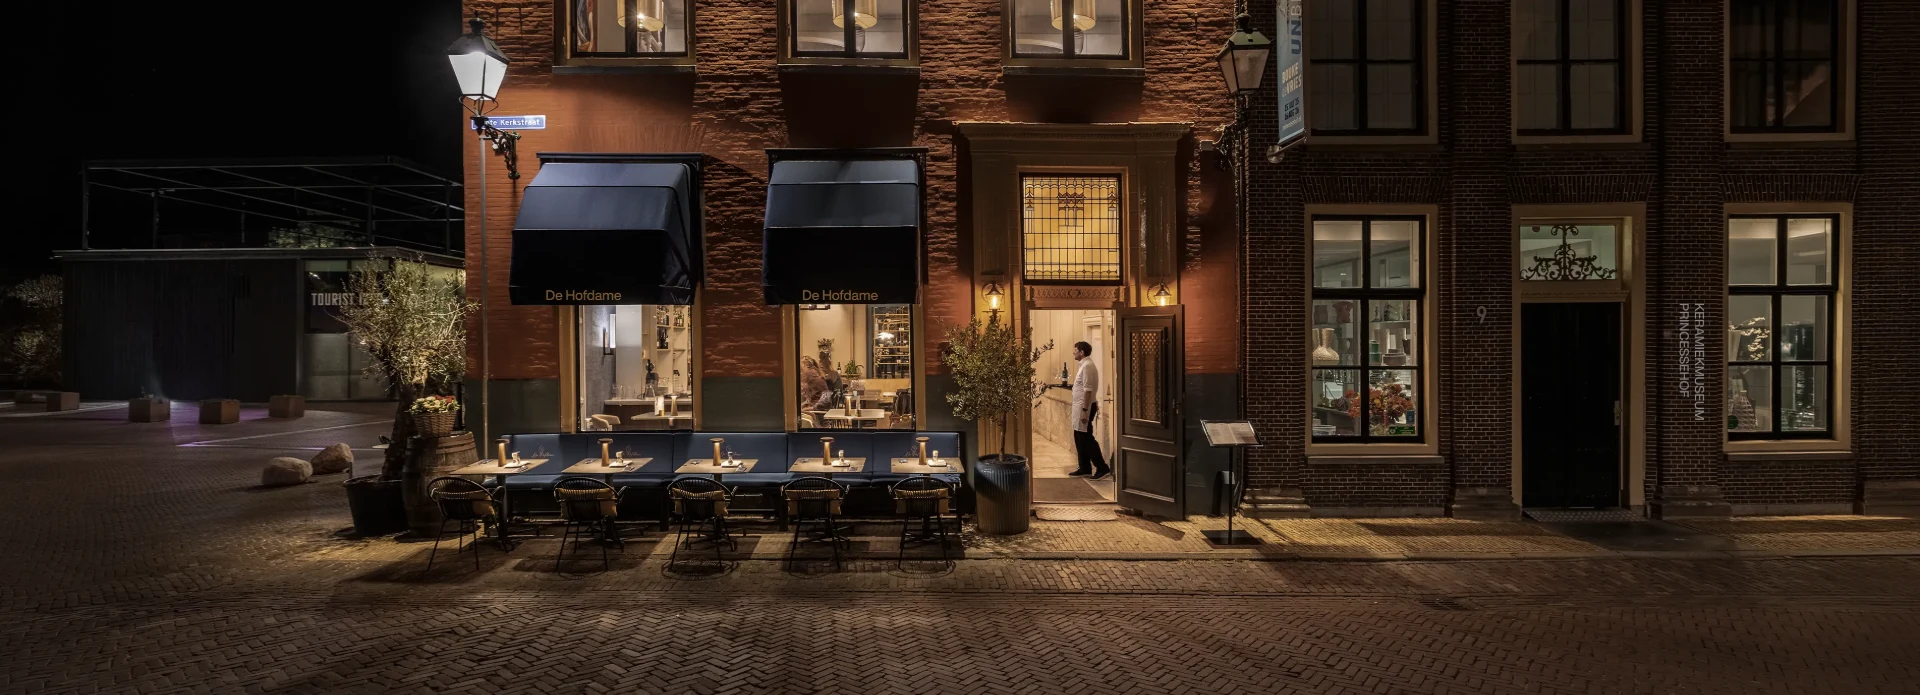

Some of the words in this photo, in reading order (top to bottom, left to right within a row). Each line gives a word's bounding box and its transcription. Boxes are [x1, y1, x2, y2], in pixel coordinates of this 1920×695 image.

[1290, 0, 1301, 55] UNB
[311, 292, 354, 306] TOURIST
[546, 290, 563, 300] De
[566, 290, 621, 300] Hofdame
[803, 290, 819, 300] De
[823, 290, 878, 300] Hofdame
[1477, 306, 1486, 323] 9
[1679, 303, 1690, 398] PRINCESSEHOF
[1694, 303, 1705, 421] KERAMIEKMUSEUM
